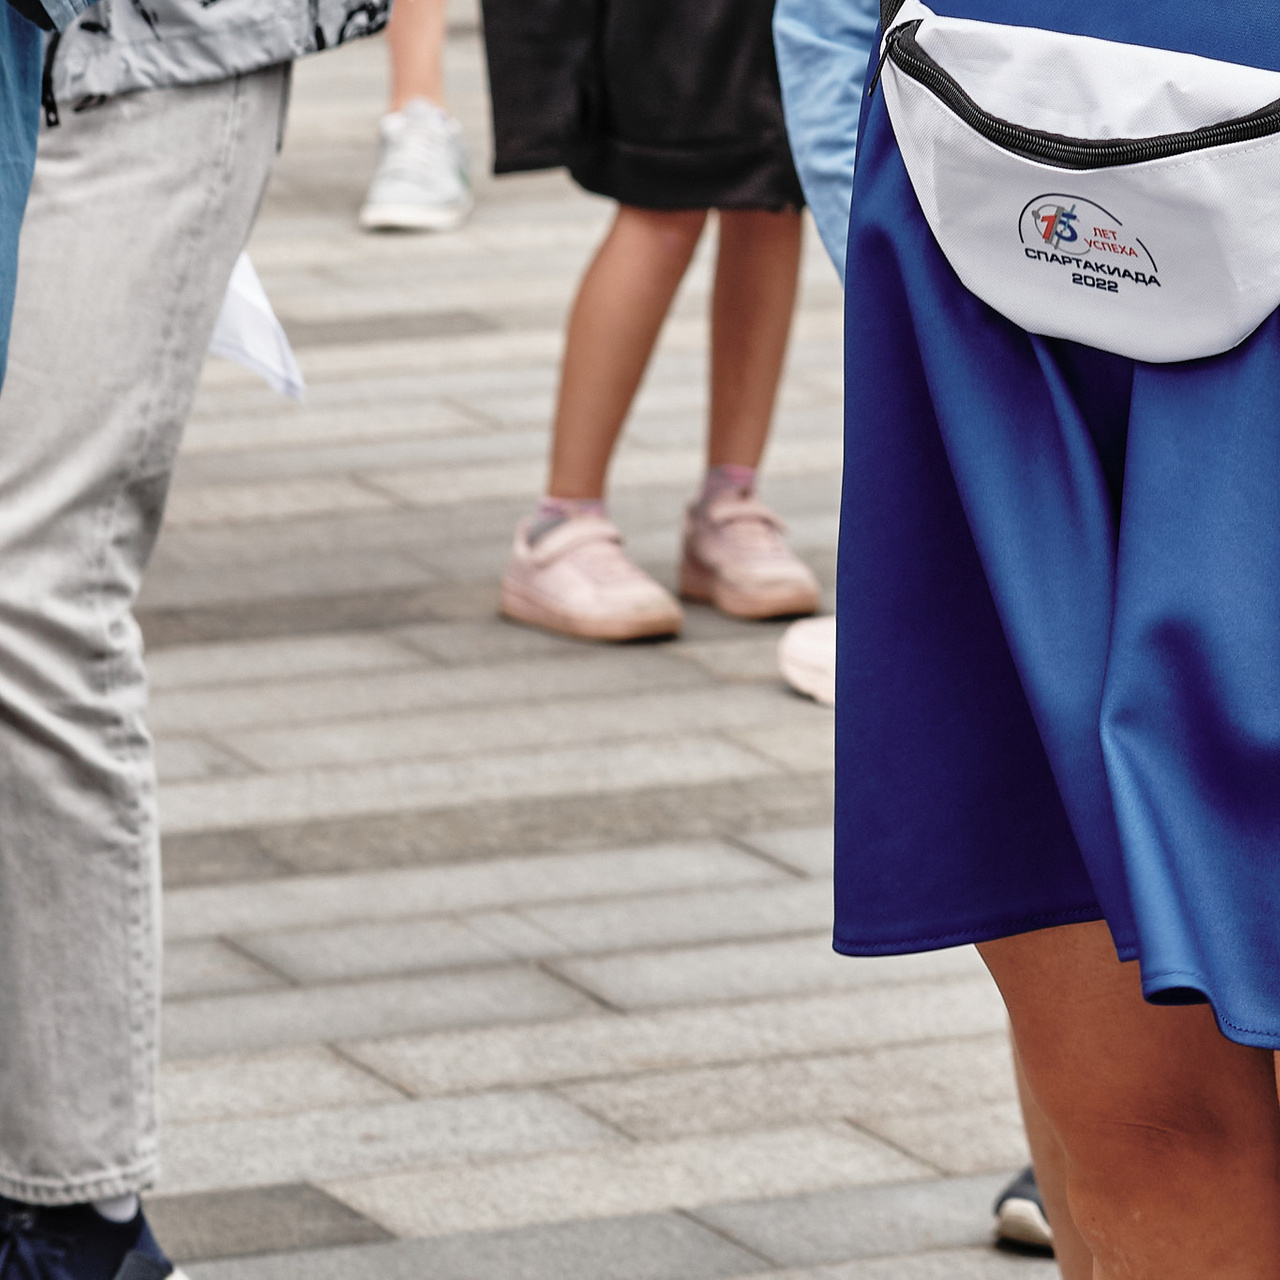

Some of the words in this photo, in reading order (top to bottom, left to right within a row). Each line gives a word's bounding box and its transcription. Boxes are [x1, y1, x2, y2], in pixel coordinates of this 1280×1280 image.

[1093, 227, 1117, 241] ЛЕТ
[1083, 237, 1139, 258] УСПЕХА
[1024, 248, 1161, 287] СПАРТАКИАДА
[1072, 272, 1119, 293] 2022
